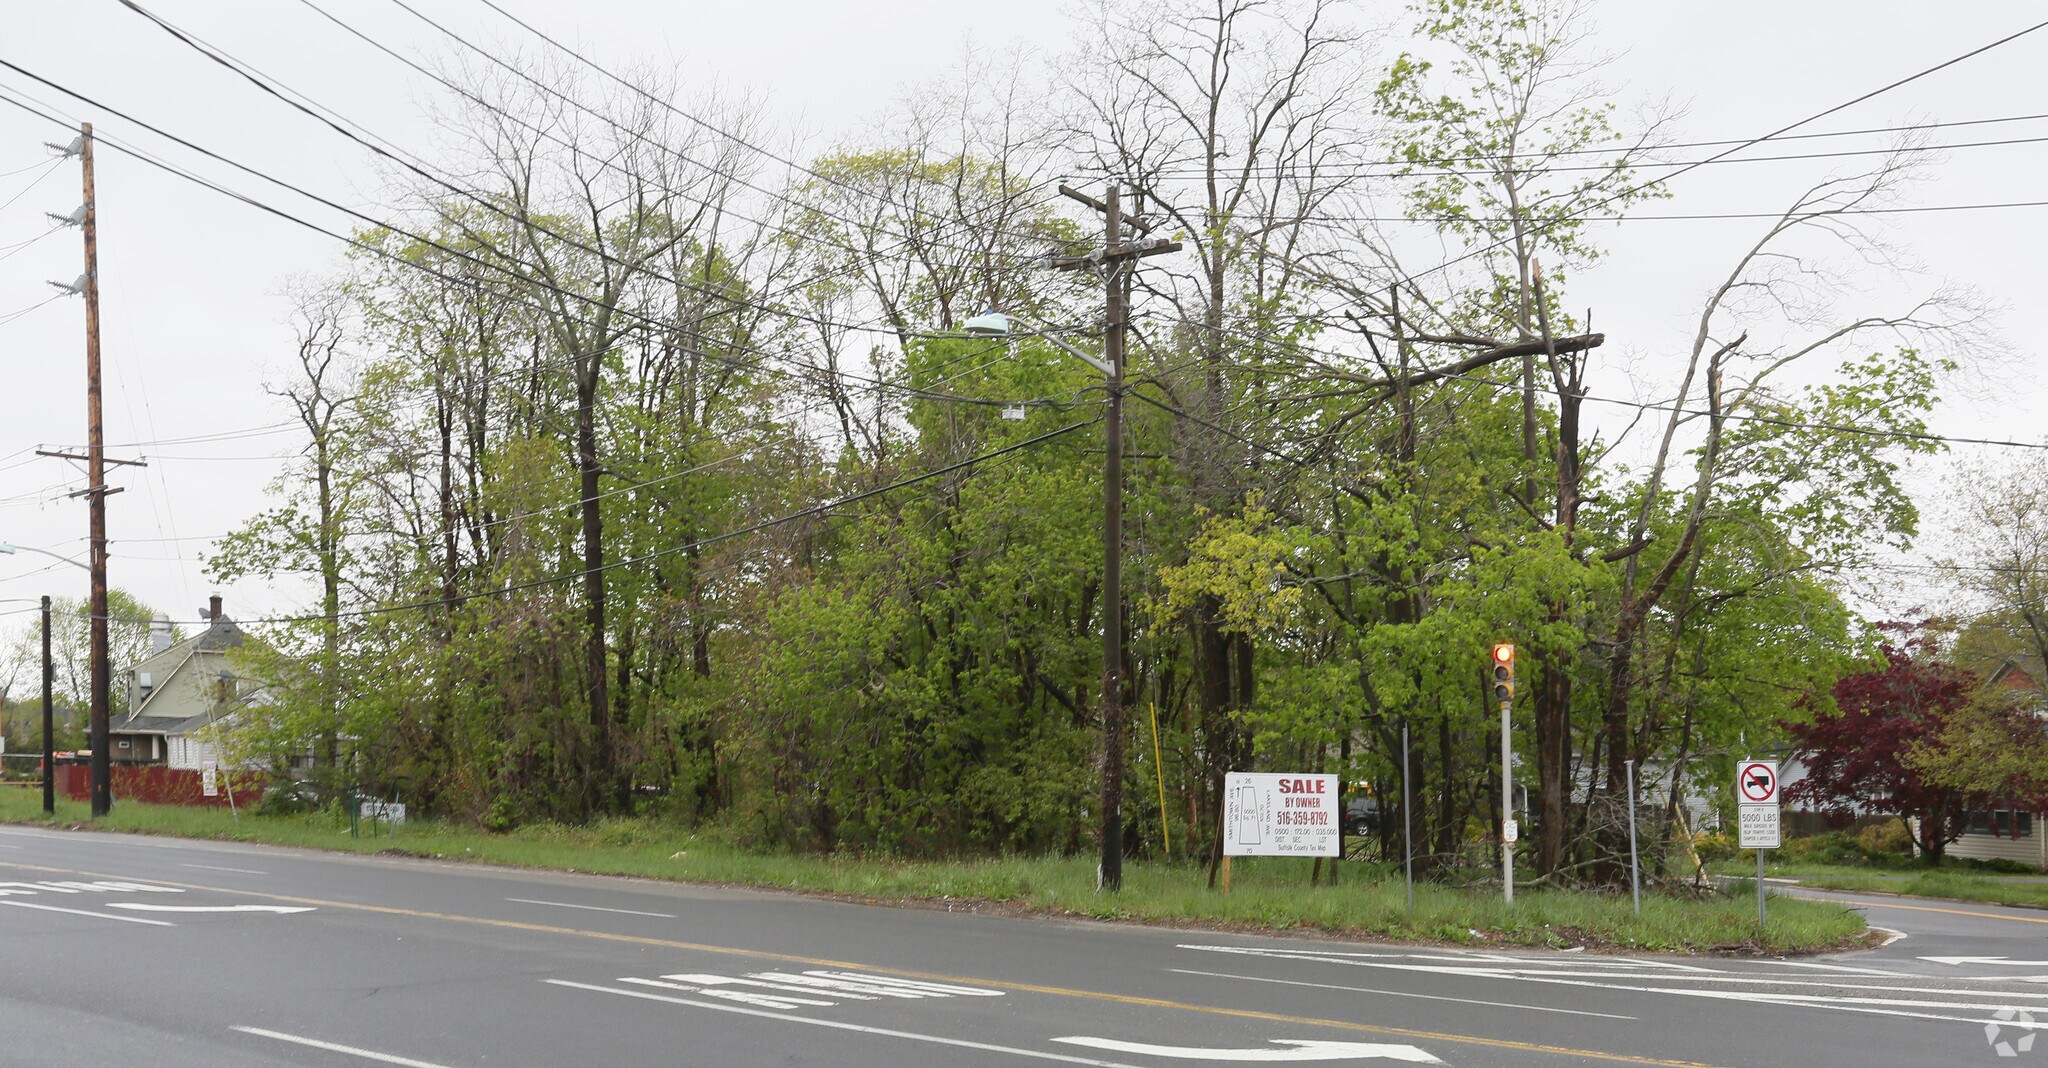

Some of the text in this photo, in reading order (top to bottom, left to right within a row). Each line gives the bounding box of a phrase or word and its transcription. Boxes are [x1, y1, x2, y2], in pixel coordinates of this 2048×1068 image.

[1278, 779, 1326, 794] SALE
[1285, 797, 1321, 808] BY OWNER
[1277, 811, 1328, 825] 516-359-8792
[1742, 813, 1776, 822] 5000 LBS
[1294, 844, 1308, 852] County
